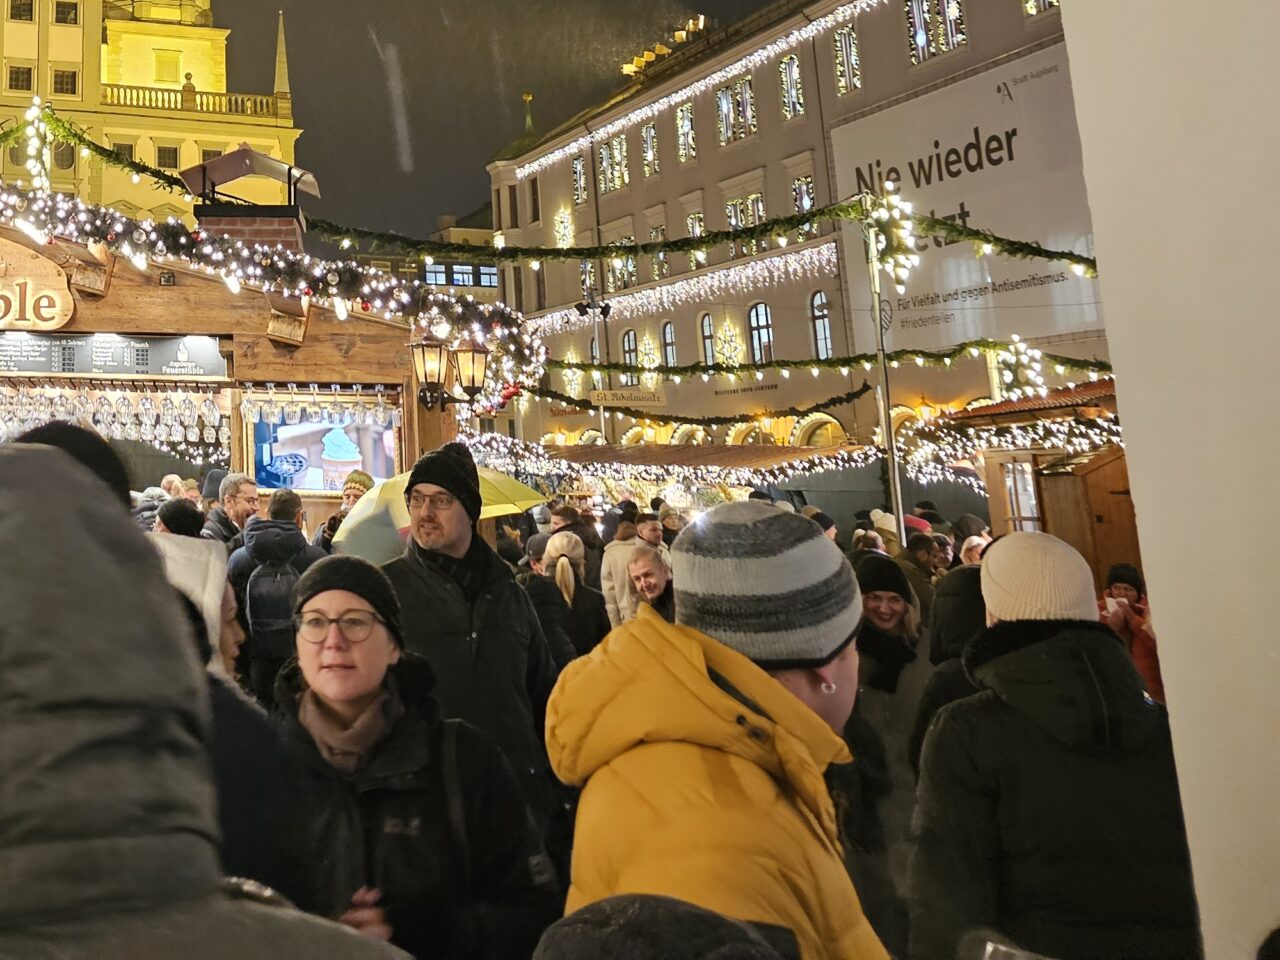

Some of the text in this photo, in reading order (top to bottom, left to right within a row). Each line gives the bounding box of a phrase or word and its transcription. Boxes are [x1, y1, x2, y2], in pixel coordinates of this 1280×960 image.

[855, 126, 1018, 196] Nie wieder
[897, 270, 1069, 311] Für Vielfalt und gegen Antisemitismus.
[900, 312, 956, 329] #friedenteilen
